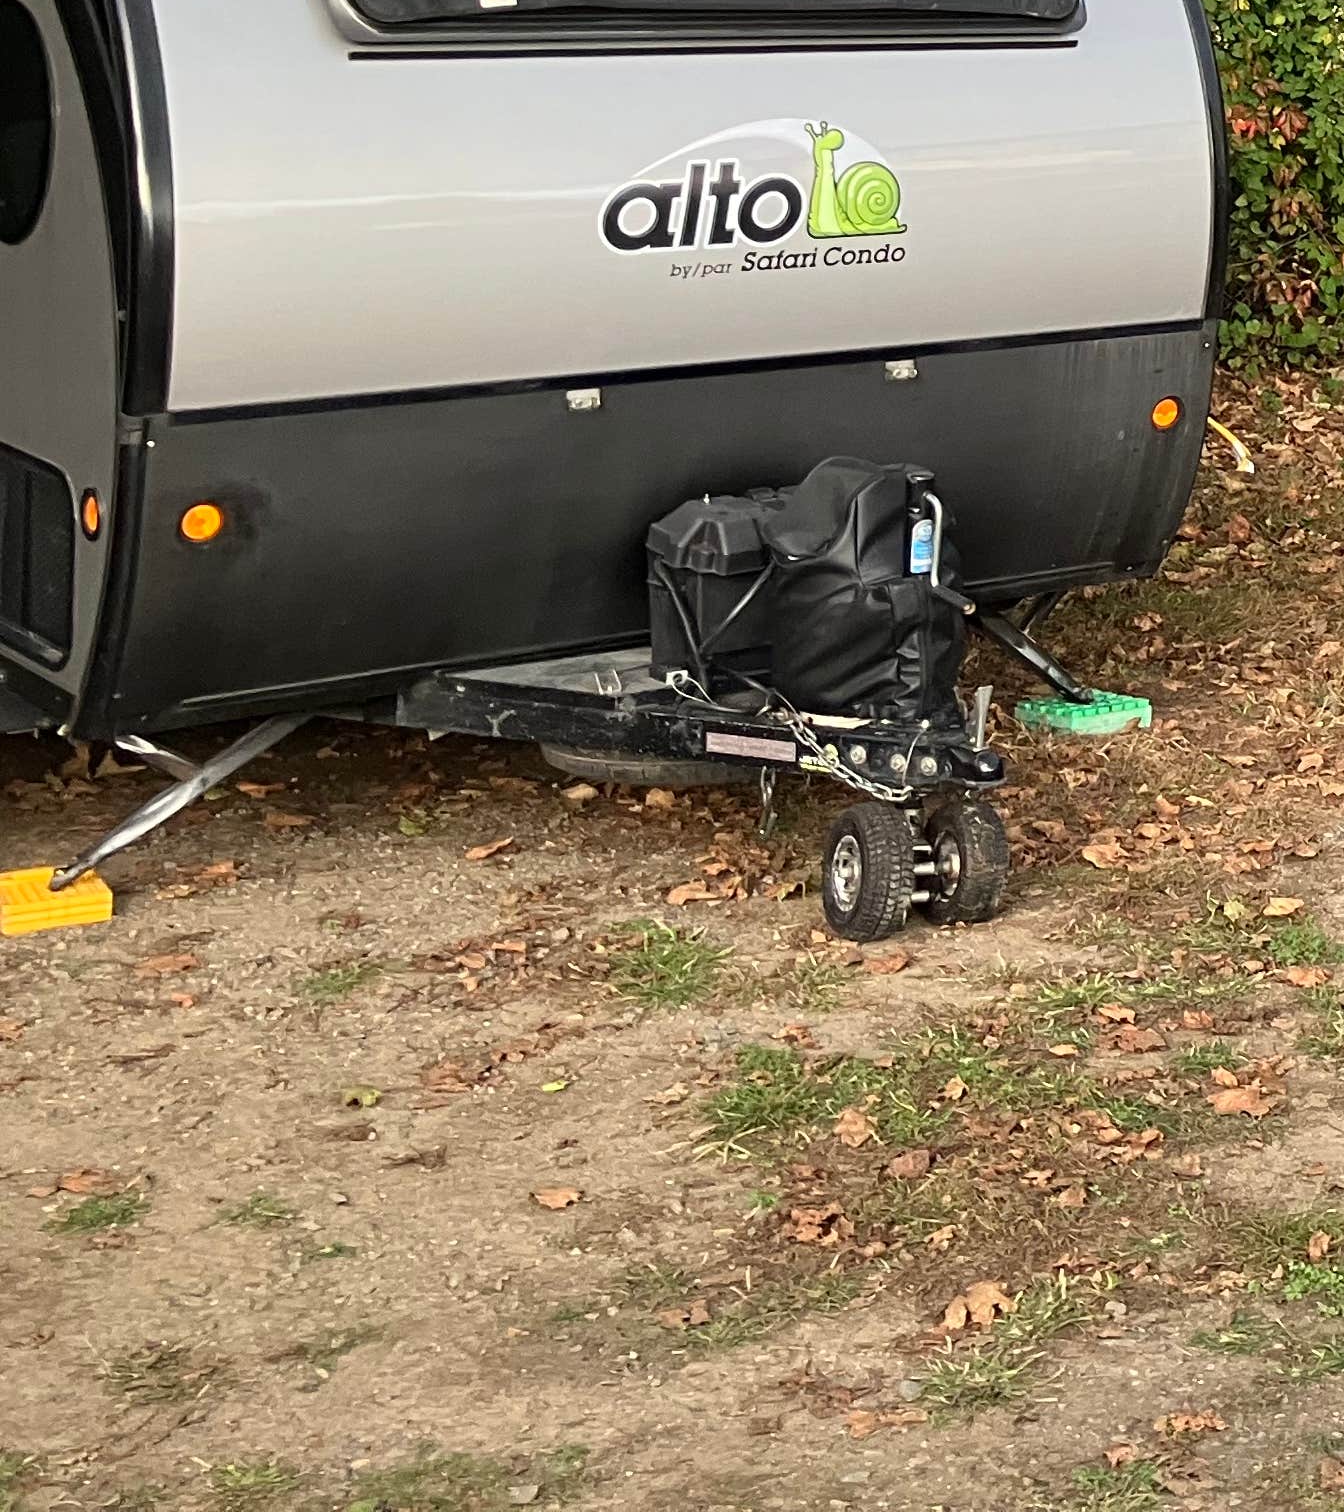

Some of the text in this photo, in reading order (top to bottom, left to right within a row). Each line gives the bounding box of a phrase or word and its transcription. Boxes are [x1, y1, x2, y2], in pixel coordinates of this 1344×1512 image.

[602, 161, 804, 252] alto
[670, 244, 907, 279] by/par Safari Condo
